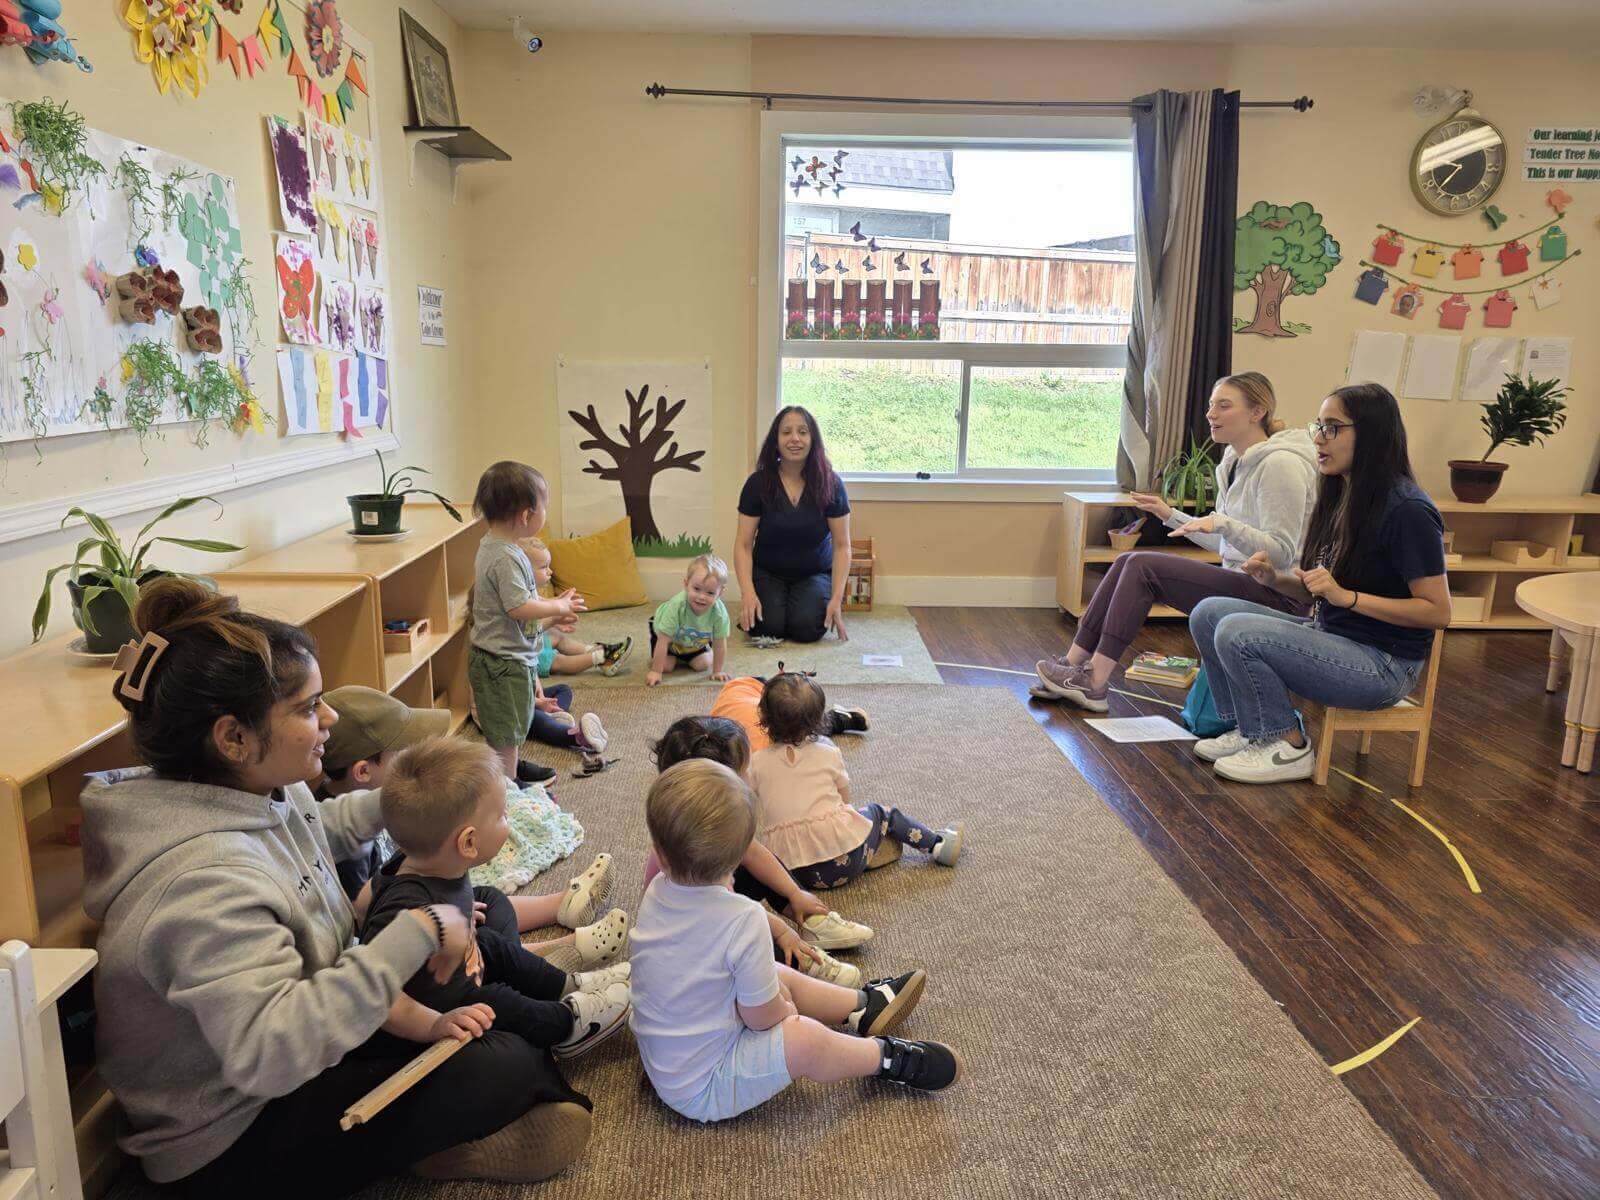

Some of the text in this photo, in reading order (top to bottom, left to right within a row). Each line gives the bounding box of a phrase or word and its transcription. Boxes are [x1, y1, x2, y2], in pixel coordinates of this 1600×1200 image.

[1533, 128, 1552, 140] Our
[1553, 128, 1593, 142] learning
[1530, 148, 1562, 160] Tender
[1564, 148, 1586, 160] Tree
[1527, 167, 1547, 179] This
[1548, 167, 1555, 179] is
[1557, 168, 1574, 179] our
